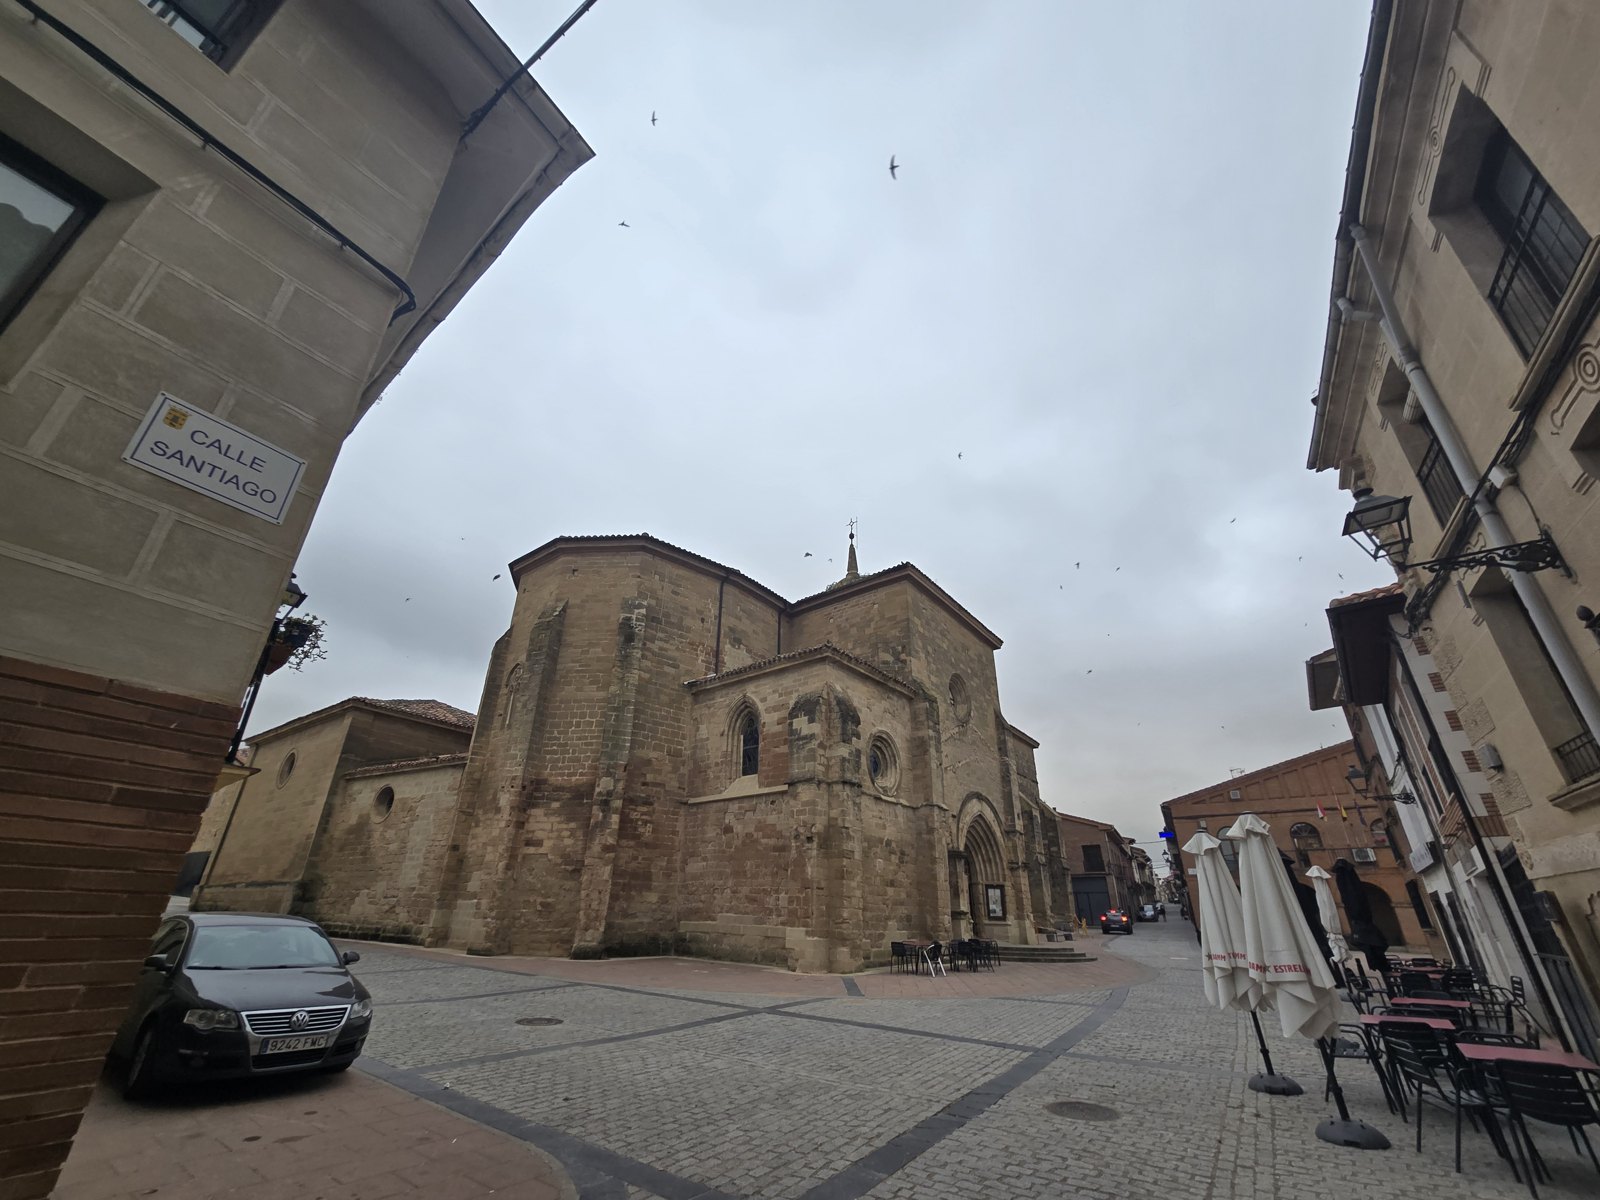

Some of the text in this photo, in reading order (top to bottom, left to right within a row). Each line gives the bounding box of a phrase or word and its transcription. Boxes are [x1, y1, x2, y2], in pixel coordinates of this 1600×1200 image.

[150, 440, 277, 503] SANTIAGO
[190, 430, 266, 473] CALLE
[270, 1039, 301, 1051] 9242
